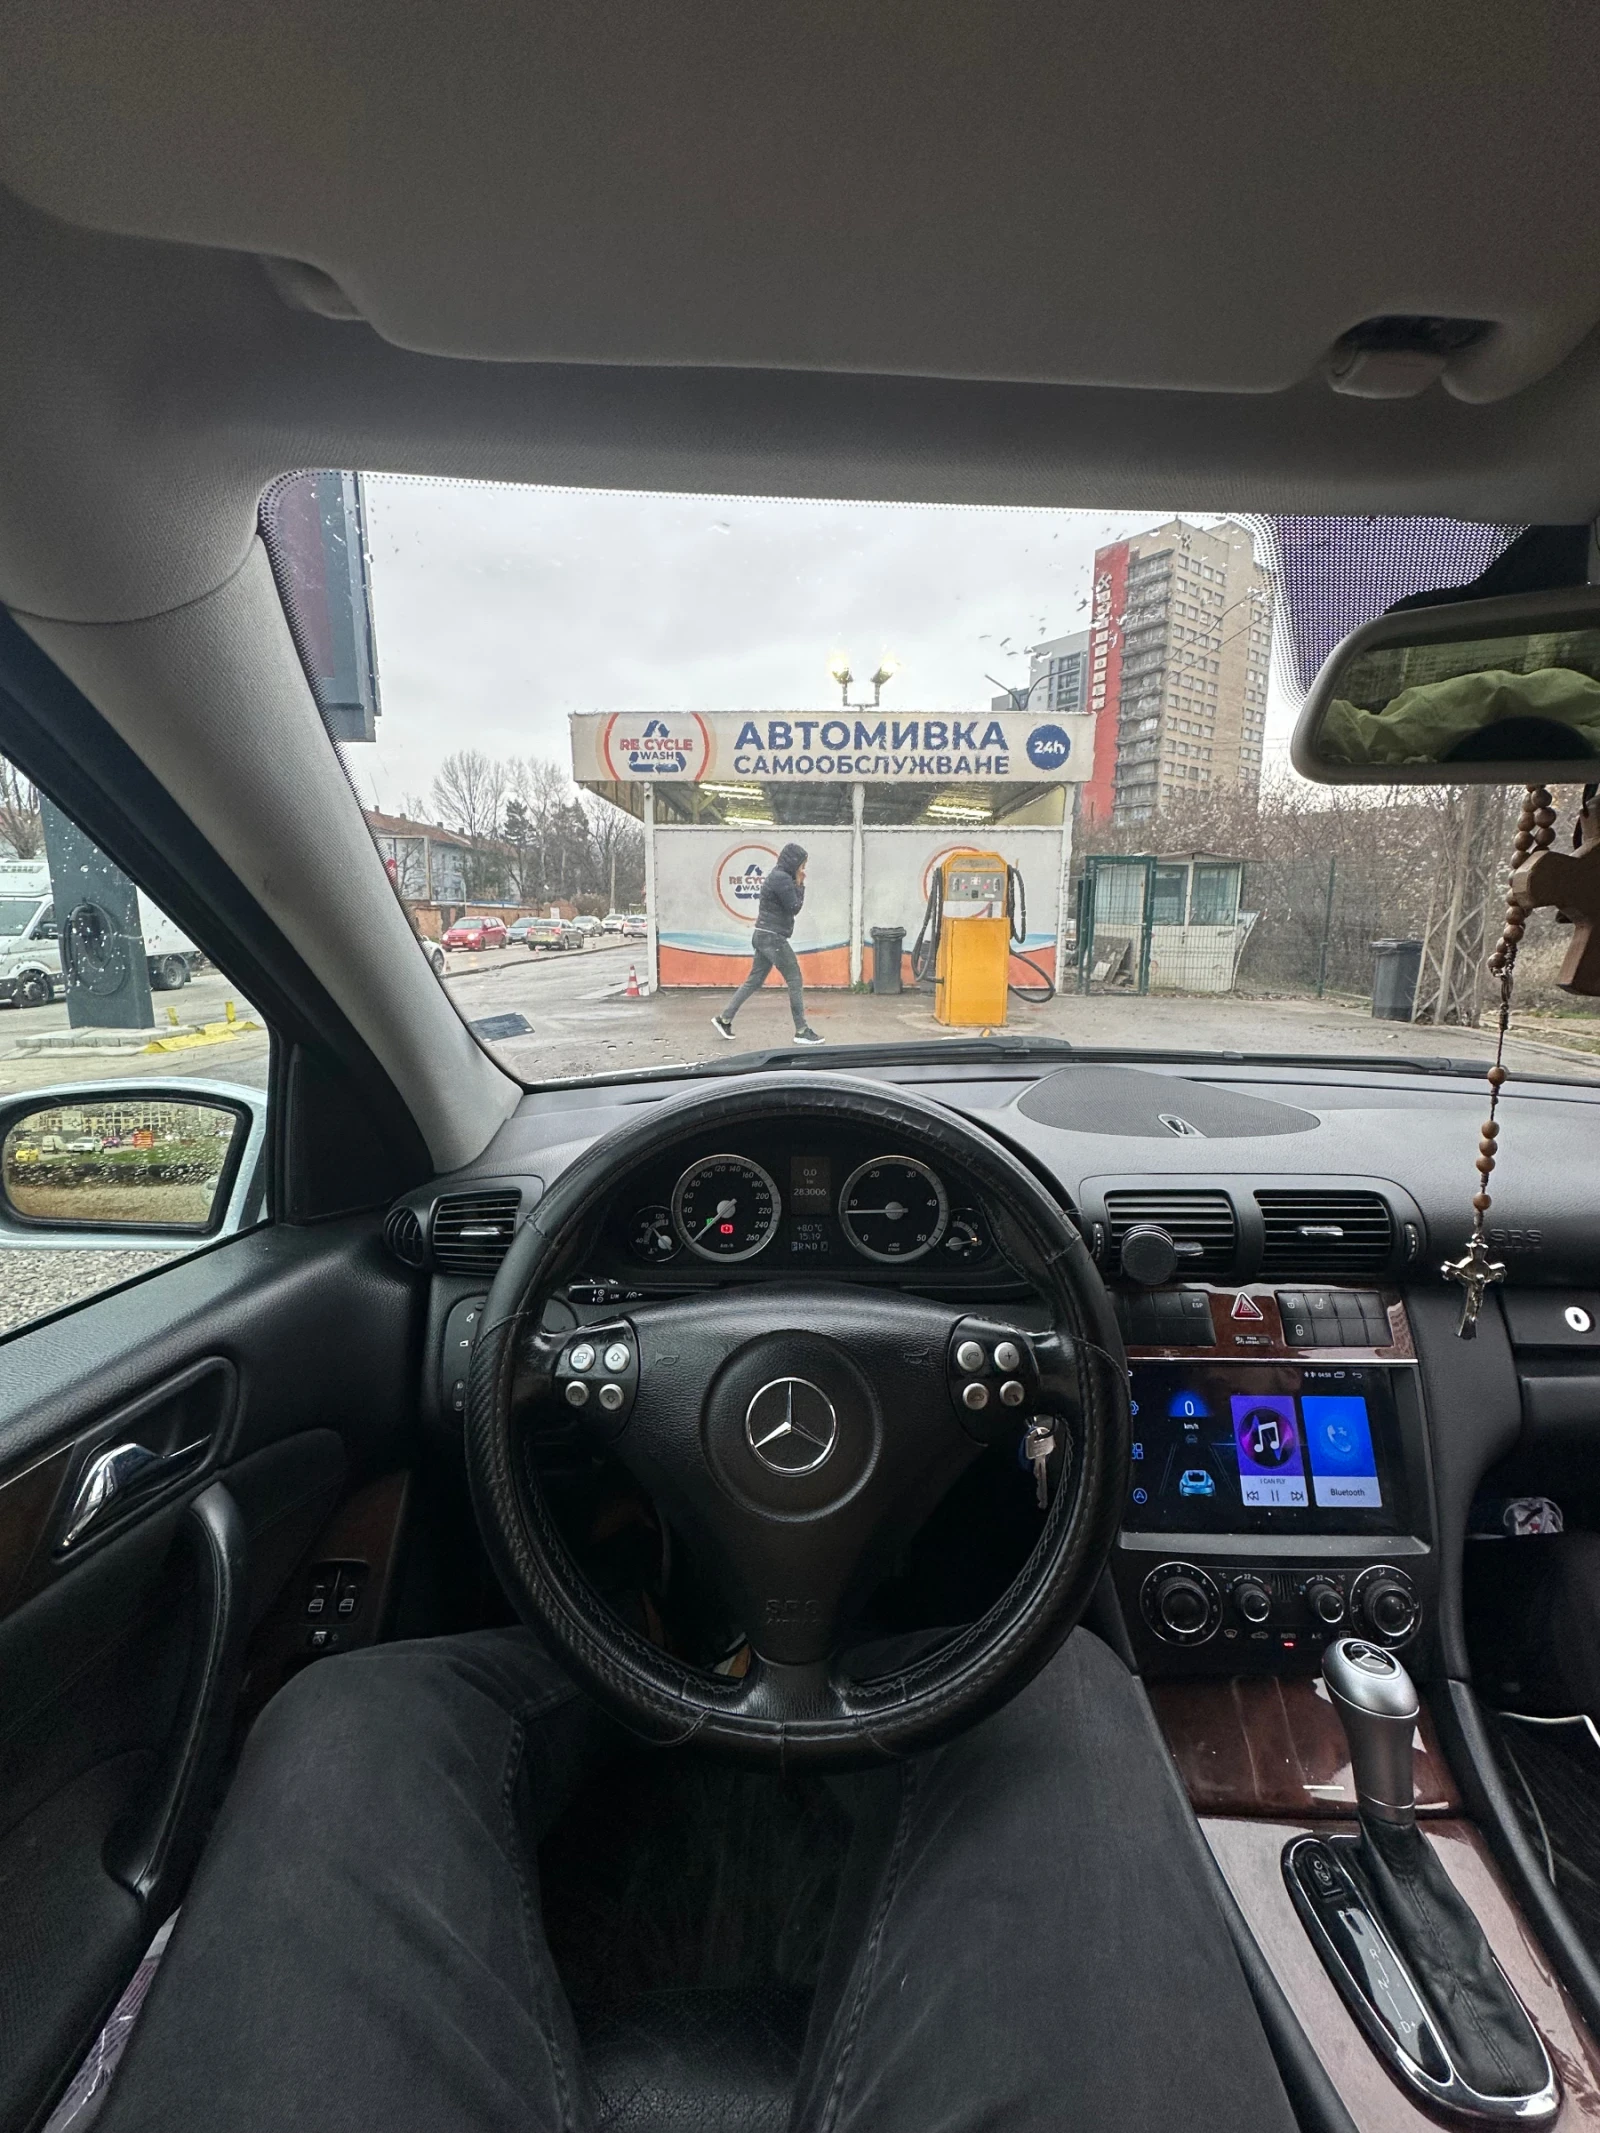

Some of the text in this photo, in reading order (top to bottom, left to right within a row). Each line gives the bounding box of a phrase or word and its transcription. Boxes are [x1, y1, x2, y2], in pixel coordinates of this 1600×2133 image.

[733, 720, 1009, 750] АВТОМИВКА
[620, 738, 693, 751] RE CYCLE
[1034, 740, 1066, 754] 24h
[640, 751, 674, 760] WASH
[733, 755, 1010, 774] САМООБСЛУЖВАНЕ
[729, 876, 766, 885] RE CYC
[803, 1168, 817, 1176] 0.0
[870, 1170, 880, 1178] 20
[906, 1170, 917, 1178] 30
[755, 1192, 770, 1200] 200
[793, 1187, 827, 1196] 283006
[927, 1199, 937, 1207] 40
[687, 1220, 697, 1228] 20
[746, 1233, 760, 1241] 260
[862, 1233, 869, 1242] 0
[916, 1234, 927, 1242] 50
[1184, 1400, 1195, 1416] 0
[1183, 1422, 1200, 1431] km/h
[1330, 1488, 1365, 1497] Bluetooth
[1176, 1565, 1182, 1573] 3
[1313, 1860, 1323, 1870] C
[1369, 1948, 1379, 1959] R
[1377, 1978, 1389, 1990] N
